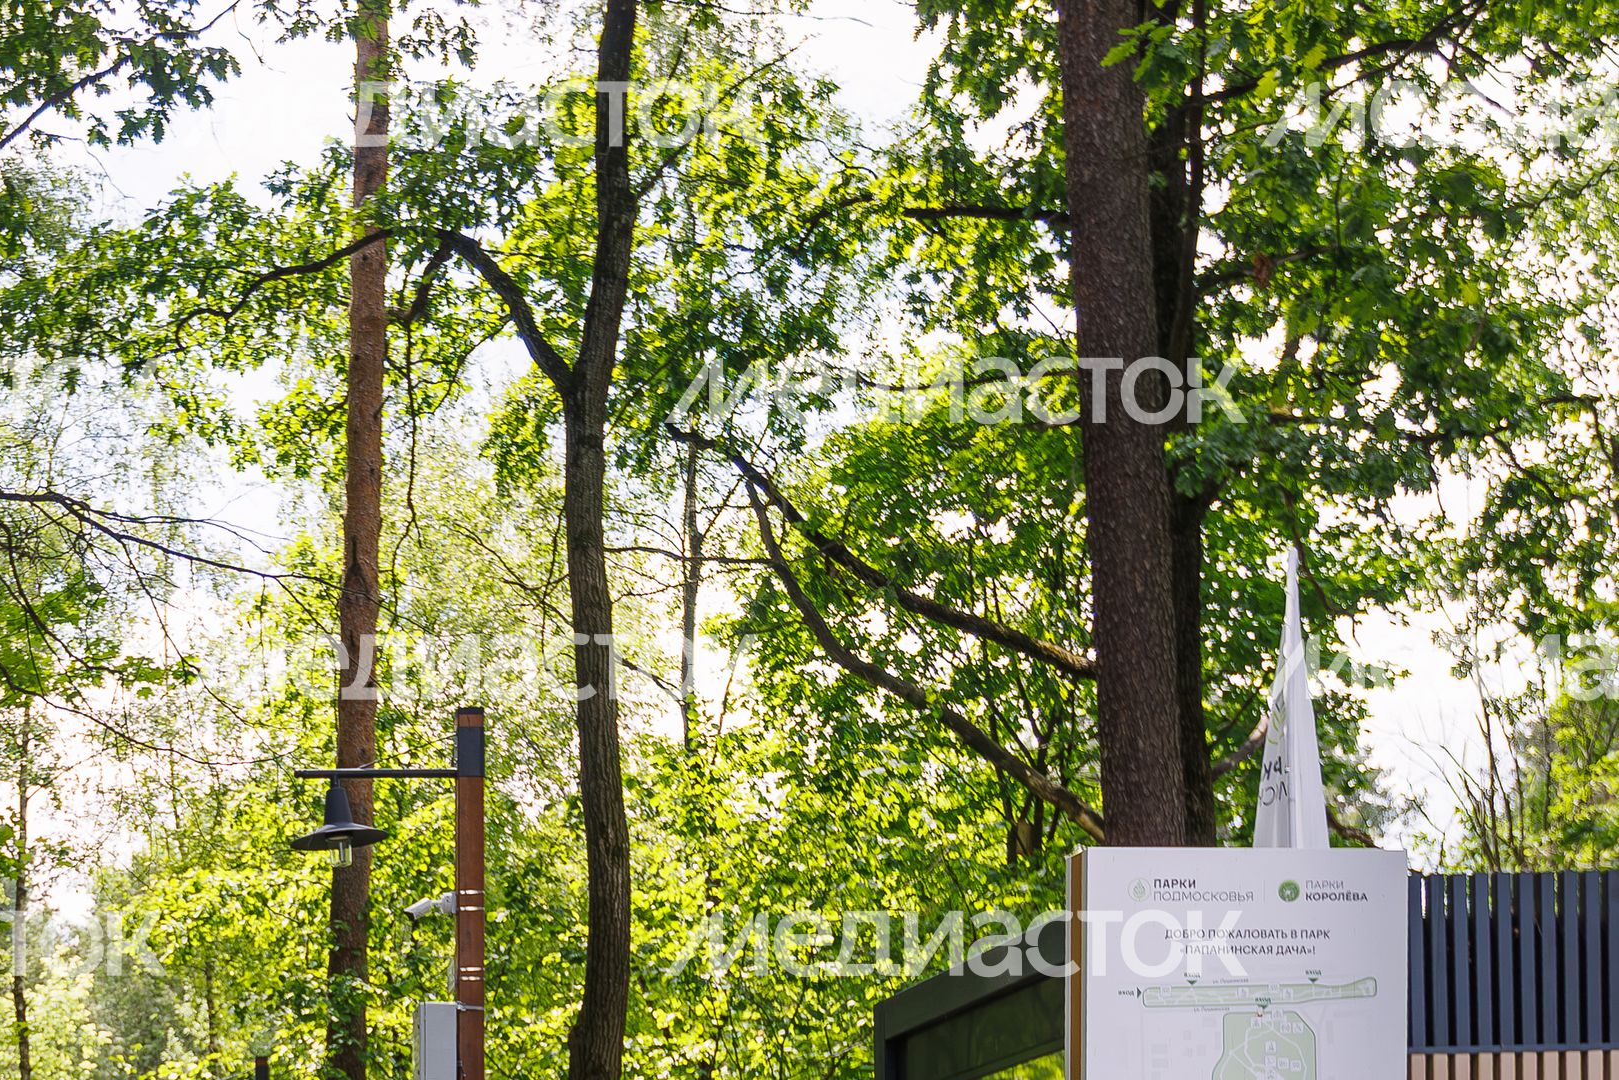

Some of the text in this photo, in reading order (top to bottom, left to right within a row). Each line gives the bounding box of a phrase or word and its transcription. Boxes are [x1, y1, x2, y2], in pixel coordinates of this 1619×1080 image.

[1153, 878, 1196, 889] ПАРКИ
[1305, 879, 1344, 890] ПАРКИ
[1153, 890, 1254, 902] ПОДМОСКОВЬЯ
[1305, 888, 1368, 902] КОРОЛЁВА
[1164, 928, 1331, 941] ДОБРО ПОЖАЛОВАТЬ В ПАРК
